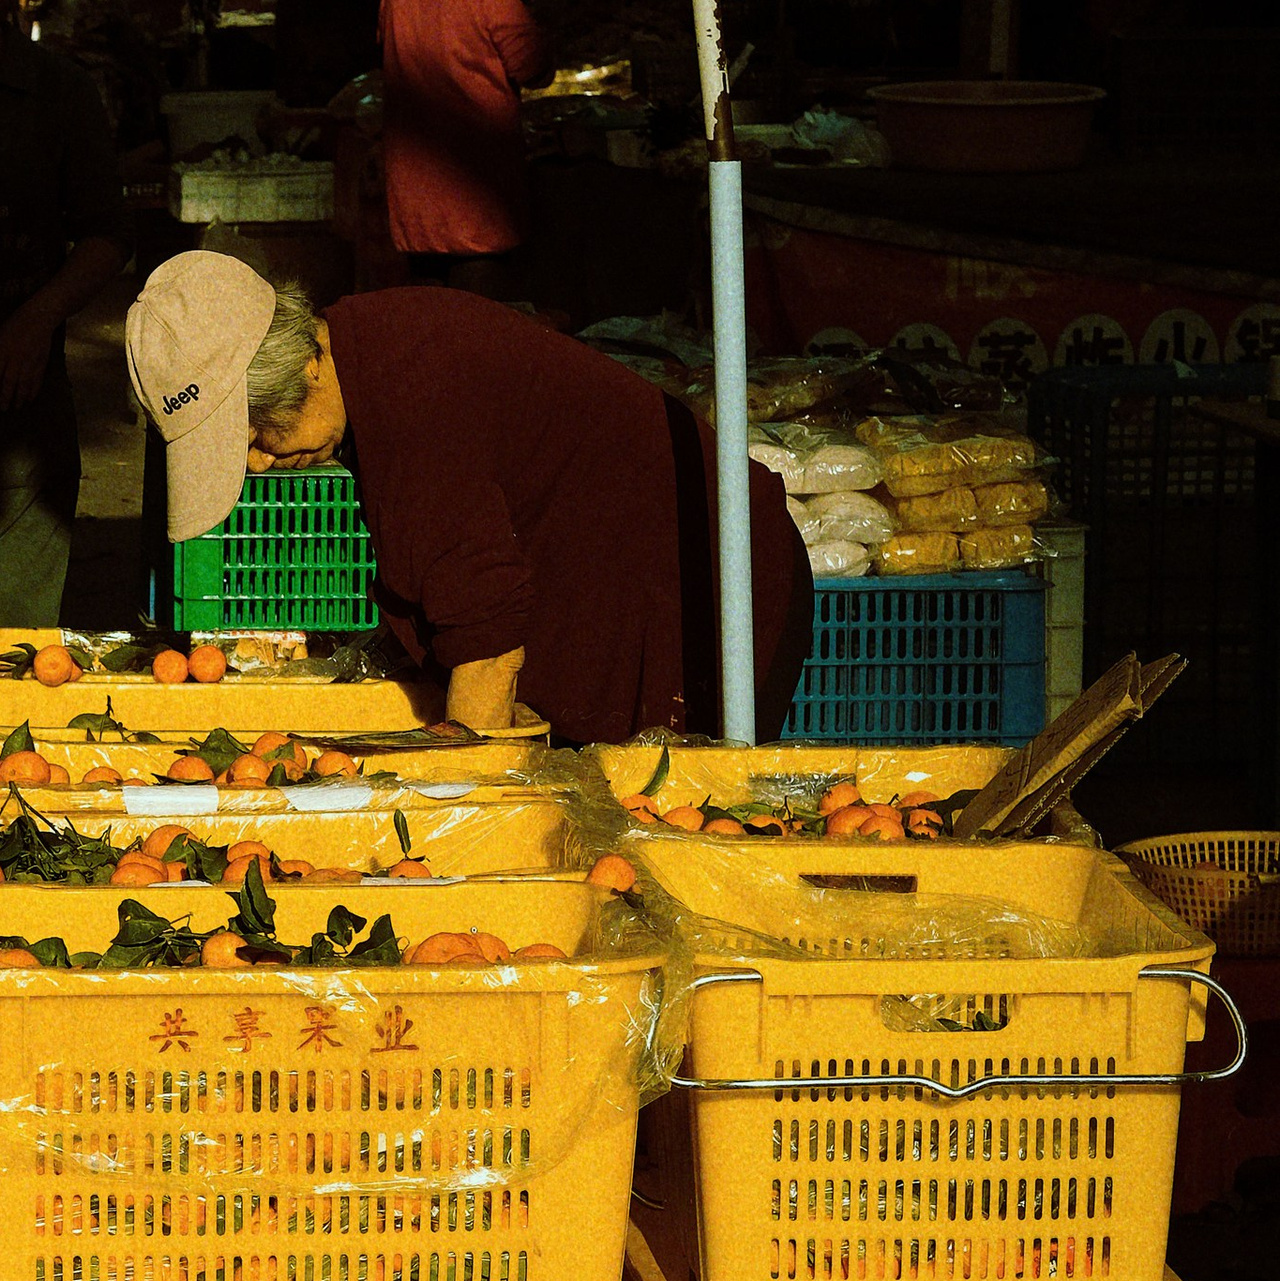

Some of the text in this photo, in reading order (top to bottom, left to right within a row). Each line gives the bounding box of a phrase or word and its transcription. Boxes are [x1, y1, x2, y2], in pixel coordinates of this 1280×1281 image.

[162, 383, 200, 416] Jeep
[148, 1004, 420, 1054] 共享果业
